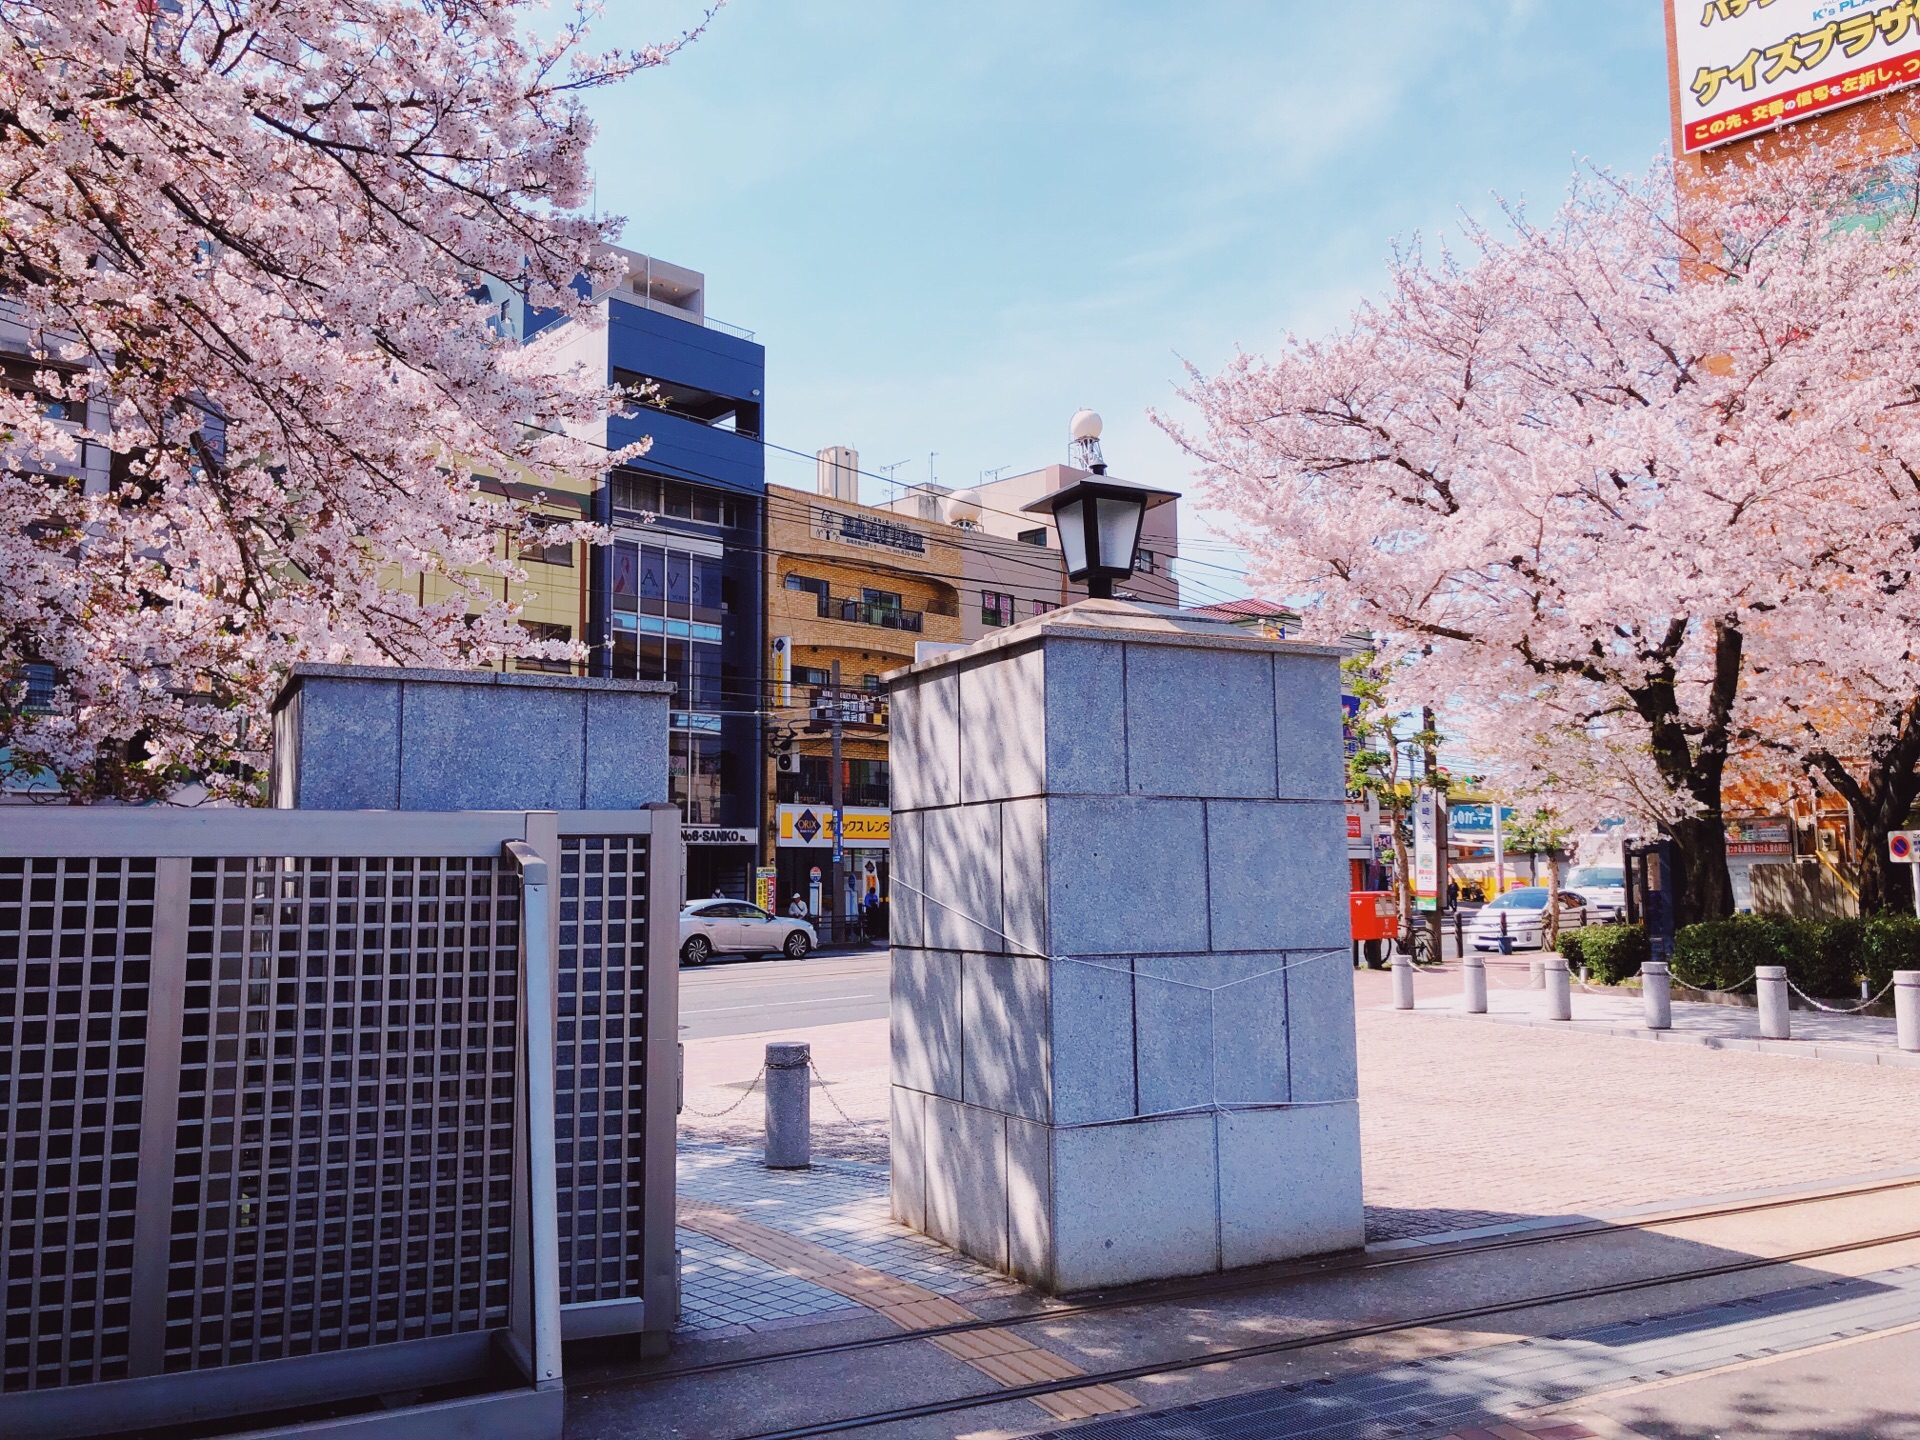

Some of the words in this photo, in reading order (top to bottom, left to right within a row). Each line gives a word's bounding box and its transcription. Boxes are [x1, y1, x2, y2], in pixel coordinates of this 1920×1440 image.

[1812, 8, 1836, 21] K's
[1690, 0, 1920, 107] ケイズプラザ
[1421, 793, 1431, 842] 長崎大学
[798, 820, 816, 829] ORIX
[825, 821, 864, 832] オックス
